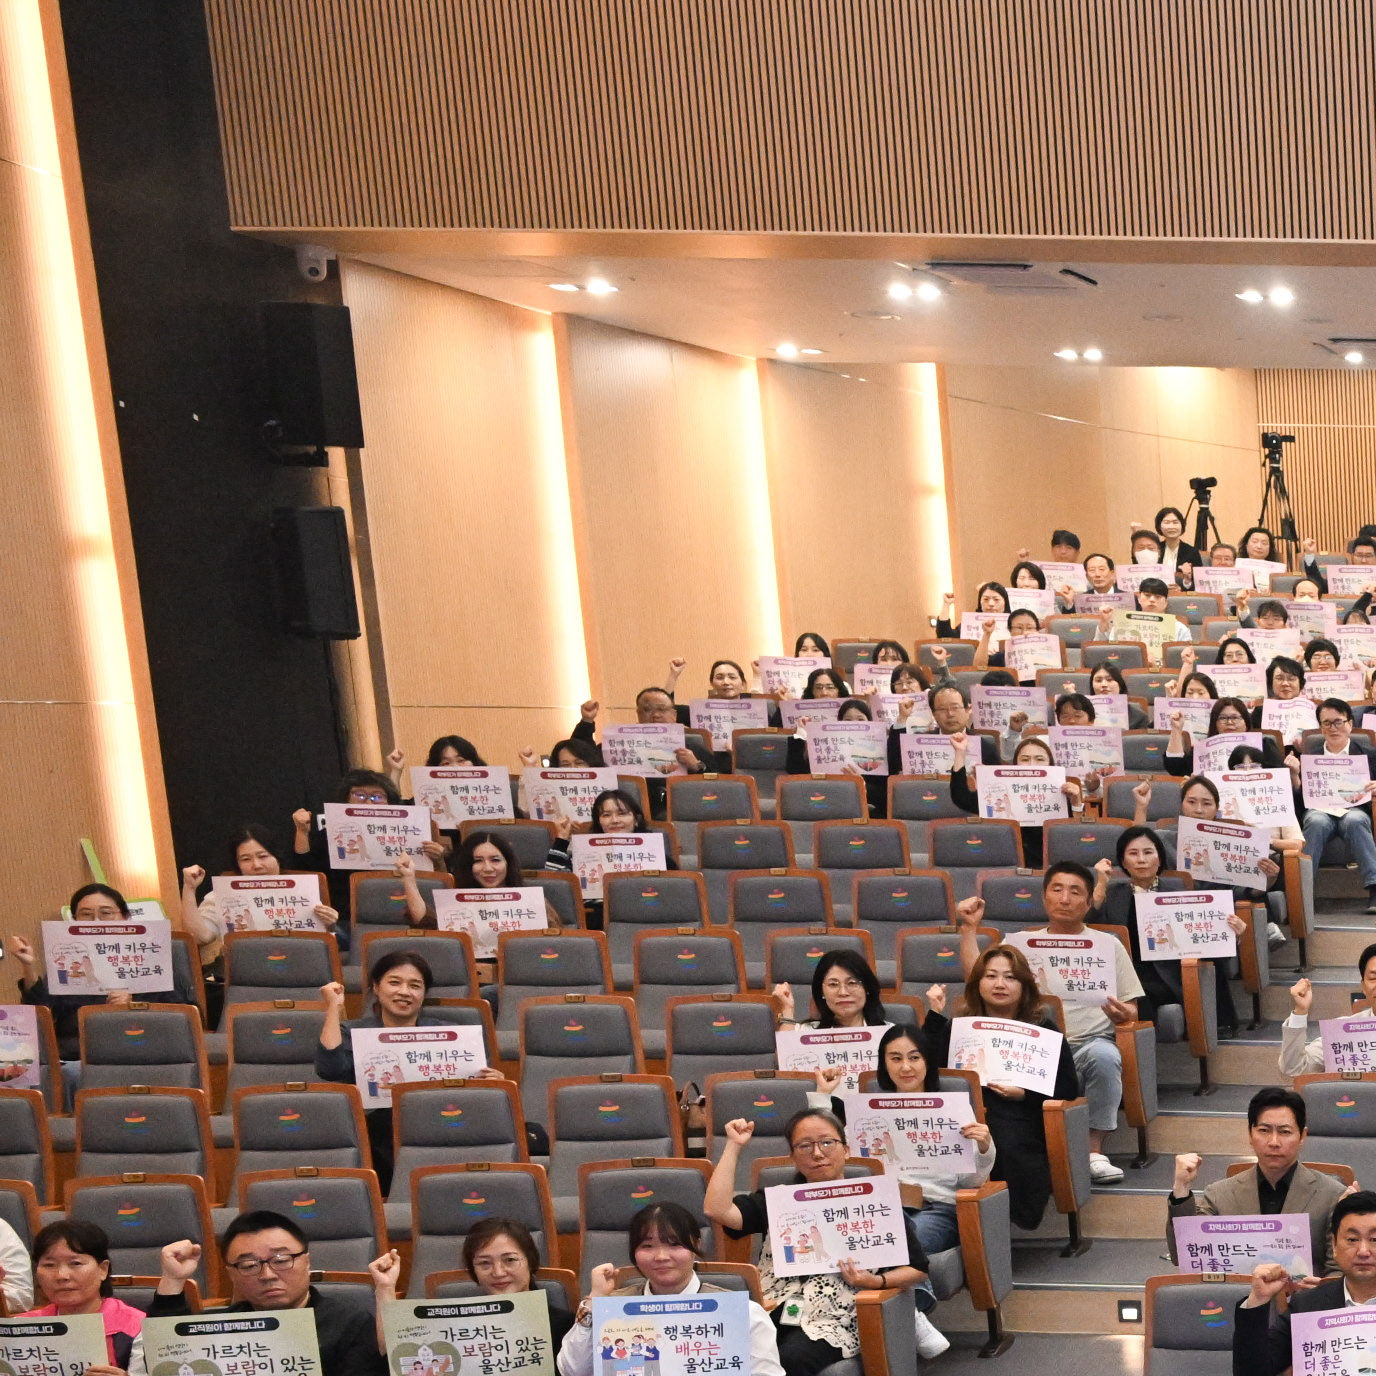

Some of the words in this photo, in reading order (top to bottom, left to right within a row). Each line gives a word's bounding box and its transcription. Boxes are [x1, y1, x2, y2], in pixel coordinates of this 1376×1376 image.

[94, 942, 120, 955] 함께
[124, 942, 162, 954] 키우는
[106, 954, 145, 967] 행복한
[115, 965, 163, 979] 울산교육
[821, 1206, 849, 1223] 함께
[852, 1202, 891, 1218] 키우는
[835, 1218, 875, 1237] 행복한
[845, 1231, 896, 1251] 울산교육
[639, 1303, 663, 1312] 학생이
[664, 1301, 702, 1312] 함께합니다
[188, 1322, 222, 1333] 교직원이
[222, 1320, 265, 1331] 함께합니다
[1324, 1314, 1353, 1326] 지역사회가
[663, 1322, 724, 1341] 행복하게
[201, 1341, 270, 1361] 가르치는
[674, 1340, 720, 1356] 배우는
[1301, 1339, 1326, 1357] 함께
[1330, 1335, 1367, 1353] 만드는
[224, 1358, 274, 1376] 보람이
[280, 1355, 315, 1373] 있는
[683, 1354, 743, 1374] 울산교육
[1304, 1359, 1316, 1372] 더
[1319, 1353, 1342, 1371] 좋은
